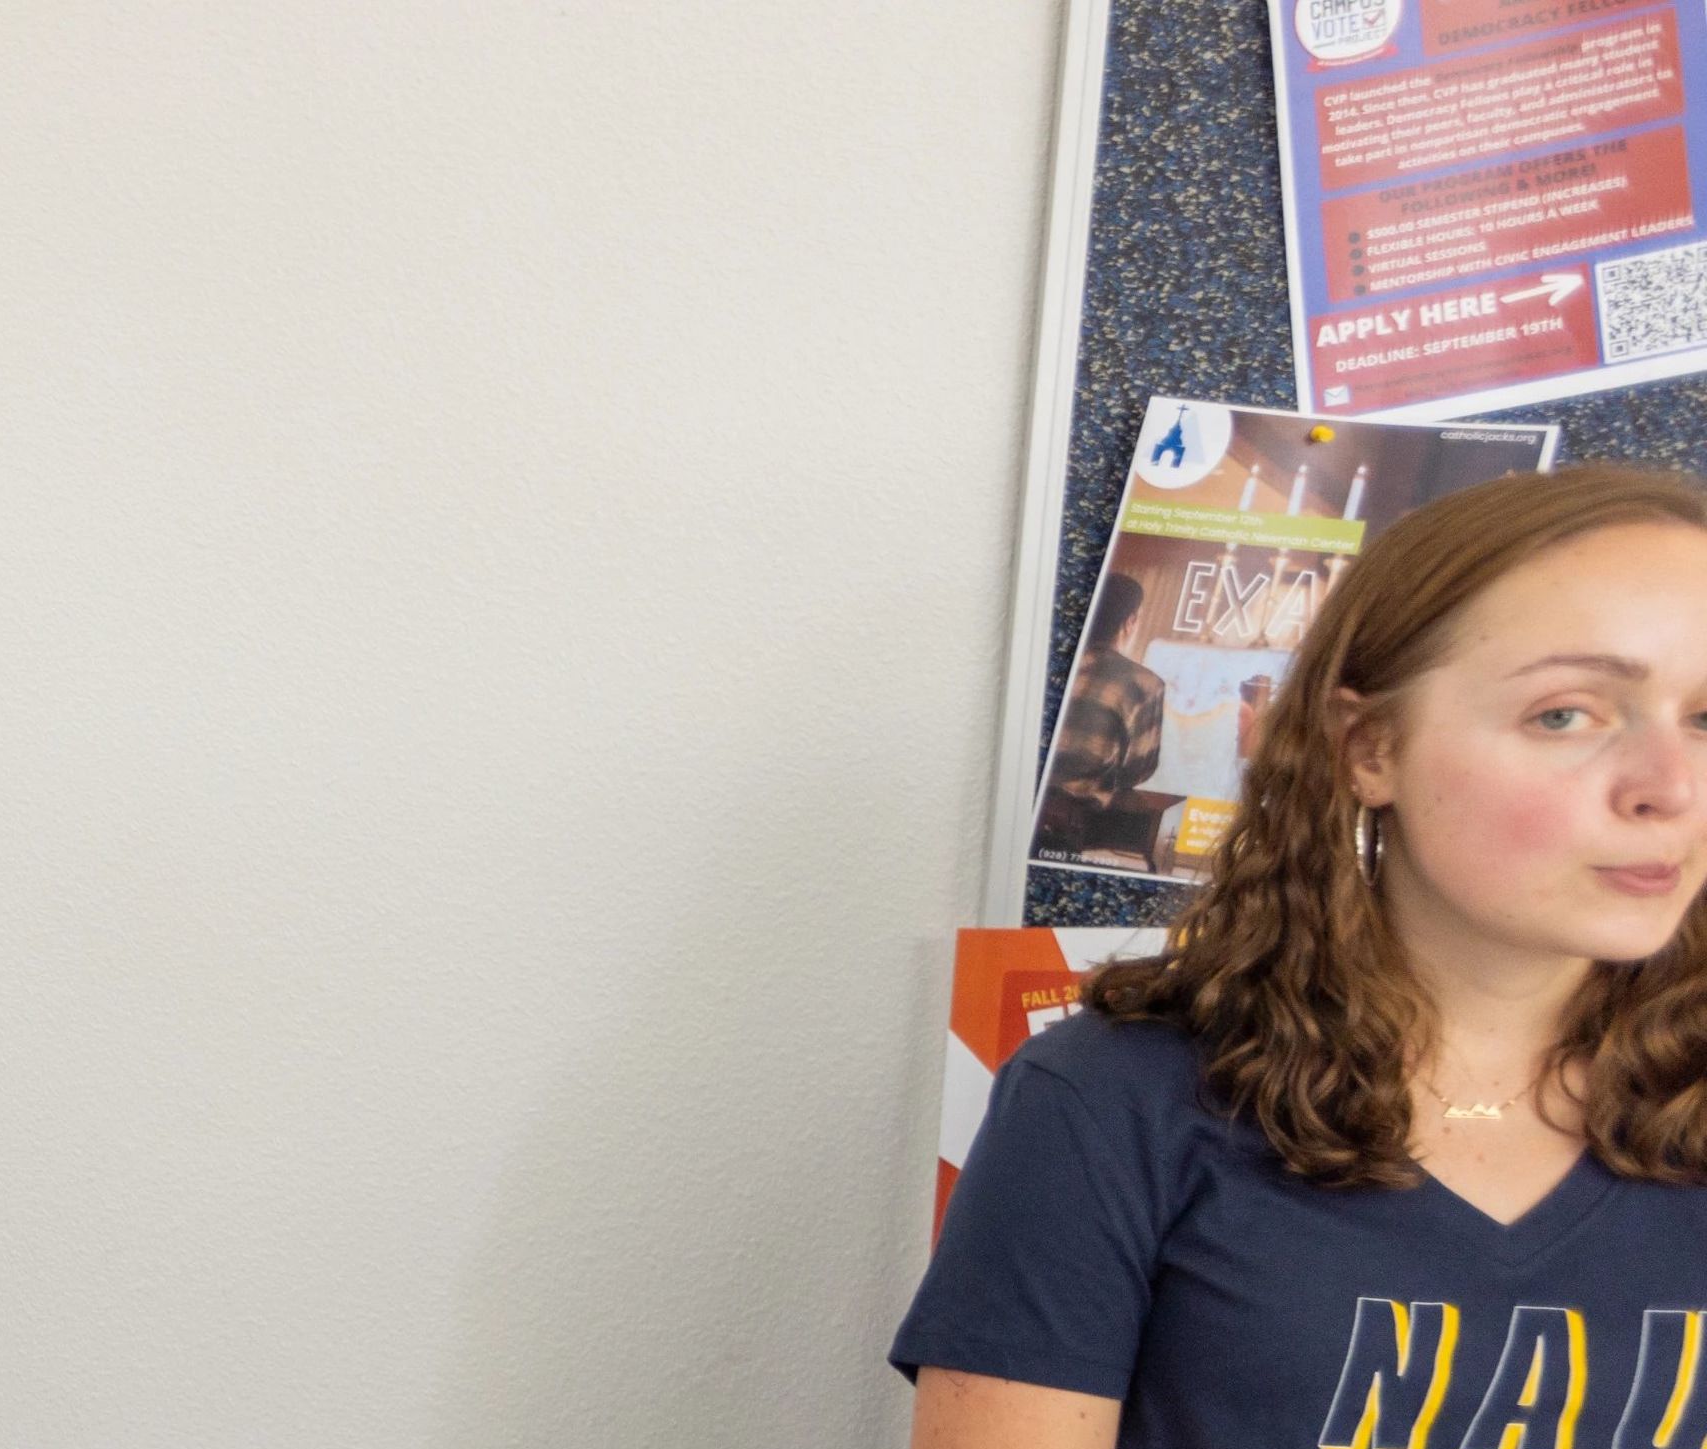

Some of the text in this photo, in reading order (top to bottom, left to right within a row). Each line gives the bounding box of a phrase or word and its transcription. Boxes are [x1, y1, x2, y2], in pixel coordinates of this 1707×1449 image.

[1311, 14, 1360, 40] VOTE
[1581, 28, 1644, 53] program
[1323, 77, 1432, 107] CVP launched the
[1362, 100, 1396, 115] Since
[1433, 85, 1460, 99] CVP
[1460, 81, 1486, 93] has
[1486, 63, 1558, 89] graduated
[1559, 56, 1599, 71] many
[1602, 40, 1659, 61] student
[1386, 102, 1459, 126] Democracy
[1511, 84, 1541, 100] play
[1555, 69, 1604, 89] critical
[1606, 62, 1635, 76] role
[1322, 132, 1389, 155] motivating
[1391, 126, 1422, 141] their
[1519, 97, 1546, 112] and
[1547, 74, 1654, 106] administrators
[1656, 69, 1674, 81] to
[1335, 88, 1660, 168] take part in nonpartisan democratic engagement
[1378, 139, 1628, 204] OUR PROGRAM OFFERS THE
[1397, 150, 1457, 170] activities
[1458, 146, 1477, 157] on
[1478, 137, 1511, 152] their
[1367, 236, 1425, 257] FLEXIBLE
[1479, 218, 1495, 234] 10
[1496, 209, 1544, 230] HOURS
[1545, 206, 1558, 220] A
[1559, 198, 1601, 217] WEEK
[1416, 207, 1482, 230] SEMESTER
[1483, 194, 1541, 217] STIPEND
[1368, 240, 1487, 274] VIRTUAL SESSIONS
[1369, 214, 1696, 293] MENTORSHIP WITH CIVIC ENGAGEMENT LEADERS
[1316, 290, 1499, 348] APPLY HERE
[1335, 342, 1420, 374] DEADLINE:
[1422, 325, 1517, 358] SEPTEMBER
[1439, 428, 1538, 446] catholicjacks.org
[1130, 503, 1172, 519] Starting
[1174, 506, 1240, 526] September
[1140, 519, 1163, 533] Holy
[1164, 521, 1197, 537] Trinity
[1198, 526, 1252, 543] Catholic
[1252, 532, 1308, 546] Newman
[1309, 536, 1356, 550] Center
[1021, 987, 1061, 1009] FALL
